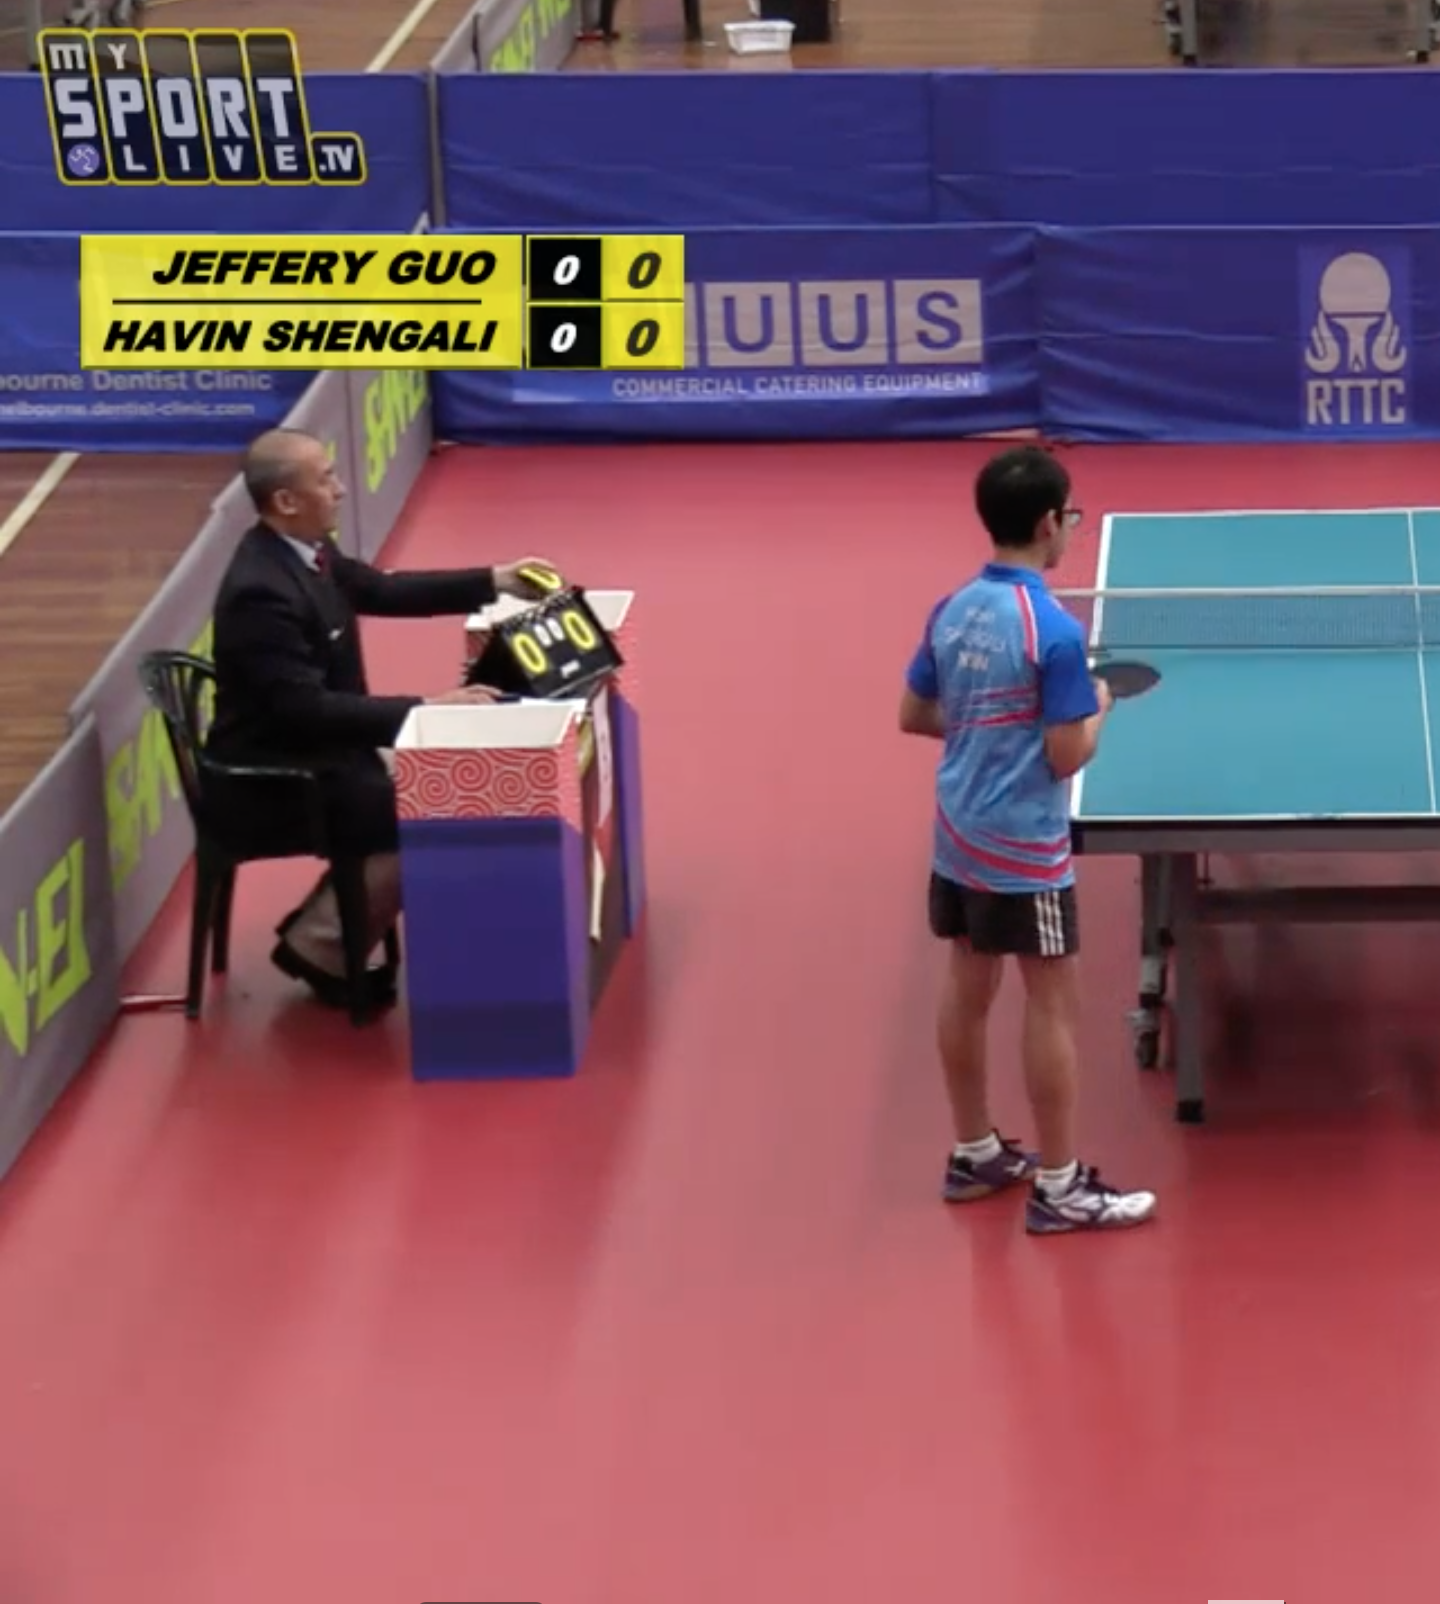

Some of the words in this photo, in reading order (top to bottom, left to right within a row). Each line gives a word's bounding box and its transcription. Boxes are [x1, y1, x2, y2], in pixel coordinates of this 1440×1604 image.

[93, 370, 188, 390] Dentist
[195, 370, 272, 390] Clinic
[612, 376, 748, 397] COMMERCIAL
[754, 374, 857, 394] CATERING
[863, 371, 983, 392] EQUIPMENT
[1306, 377, 1406, 426] RTTC
